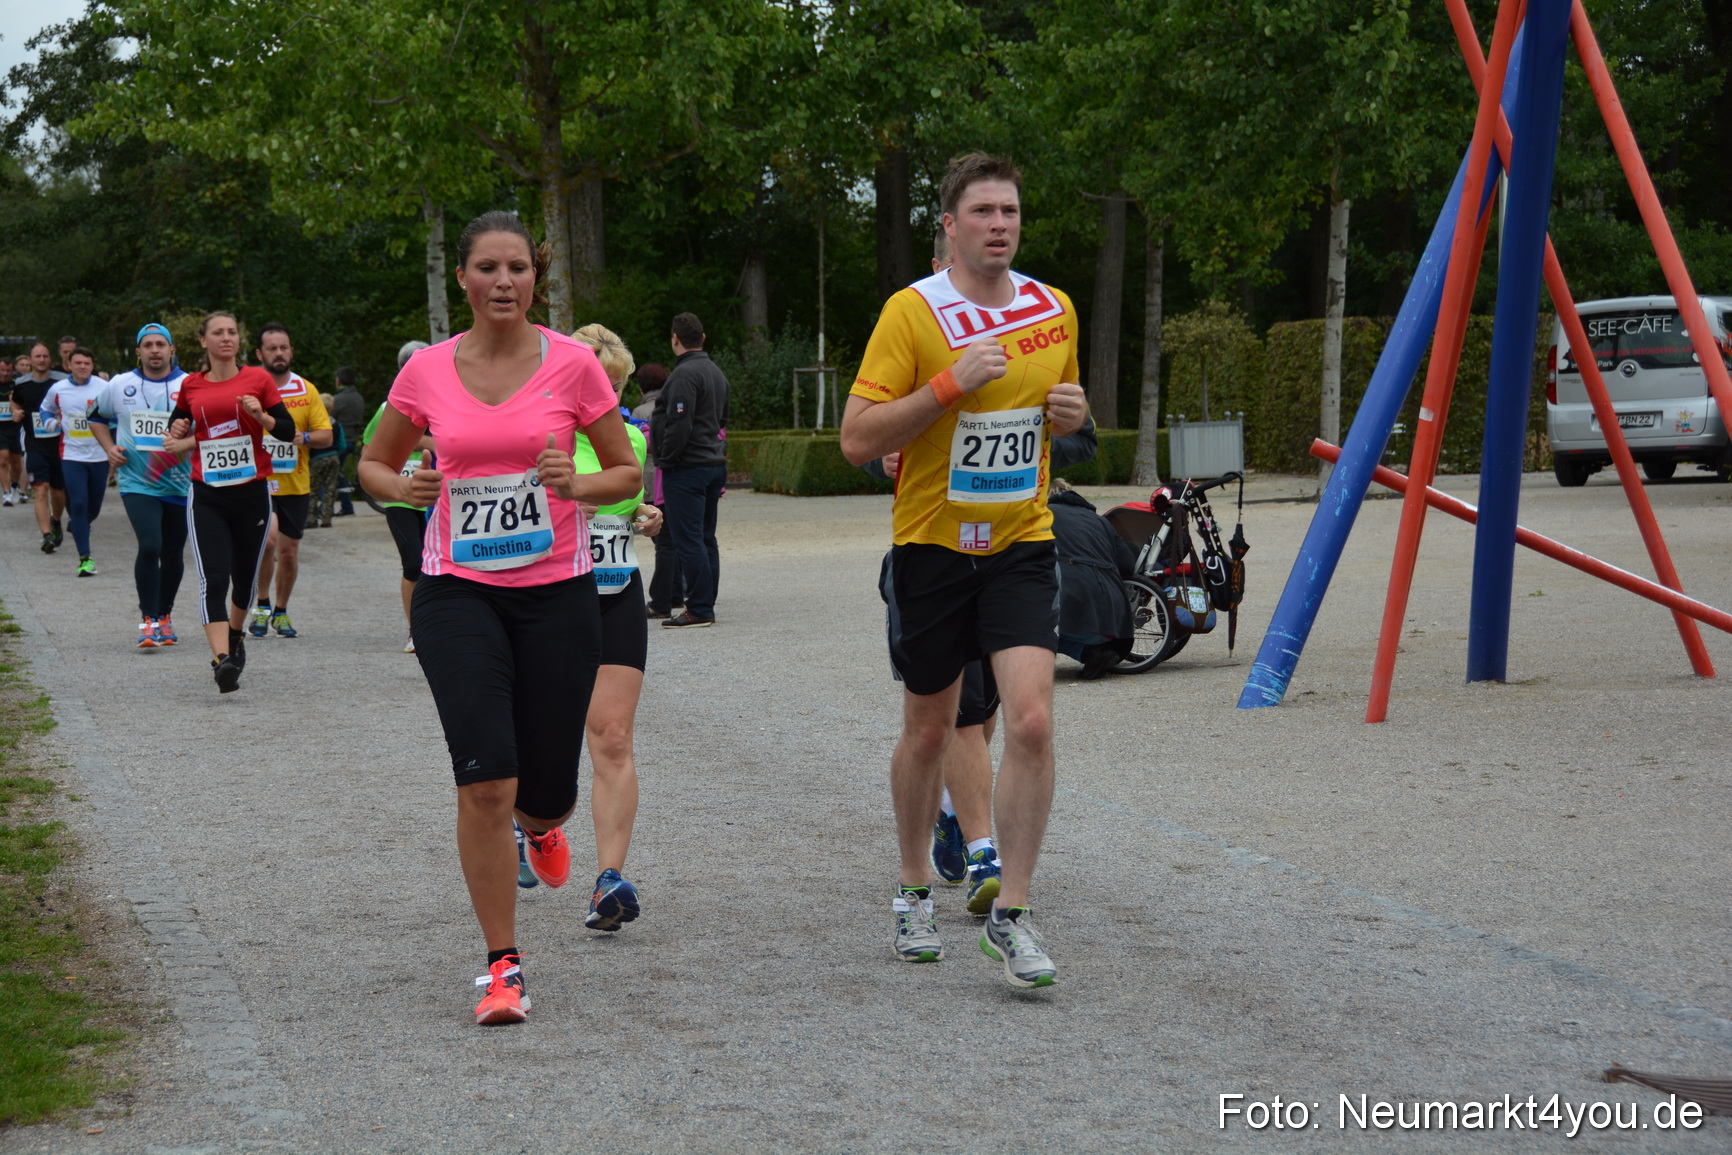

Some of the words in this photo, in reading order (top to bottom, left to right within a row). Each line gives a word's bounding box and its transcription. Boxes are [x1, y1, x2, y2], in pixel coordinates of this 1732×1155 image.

[1016, 324, 1069, 356] BÖGL
[958, 420, 989, 431] PARTL
[990, 418, 1030, 429] Neumarkt
[1639, 415, 1651, 424] 22
[961, 430, 1036, 468] 2730
[206, 448, 250, 469] 2594
[217, 470, 243, 480] Regina
[971, 475, 1025, 490] Christian
[450, 486, 482, 496] PARTL
[461, 492, 541, 535] 2784
[471, 540, 532, 558] Christina
